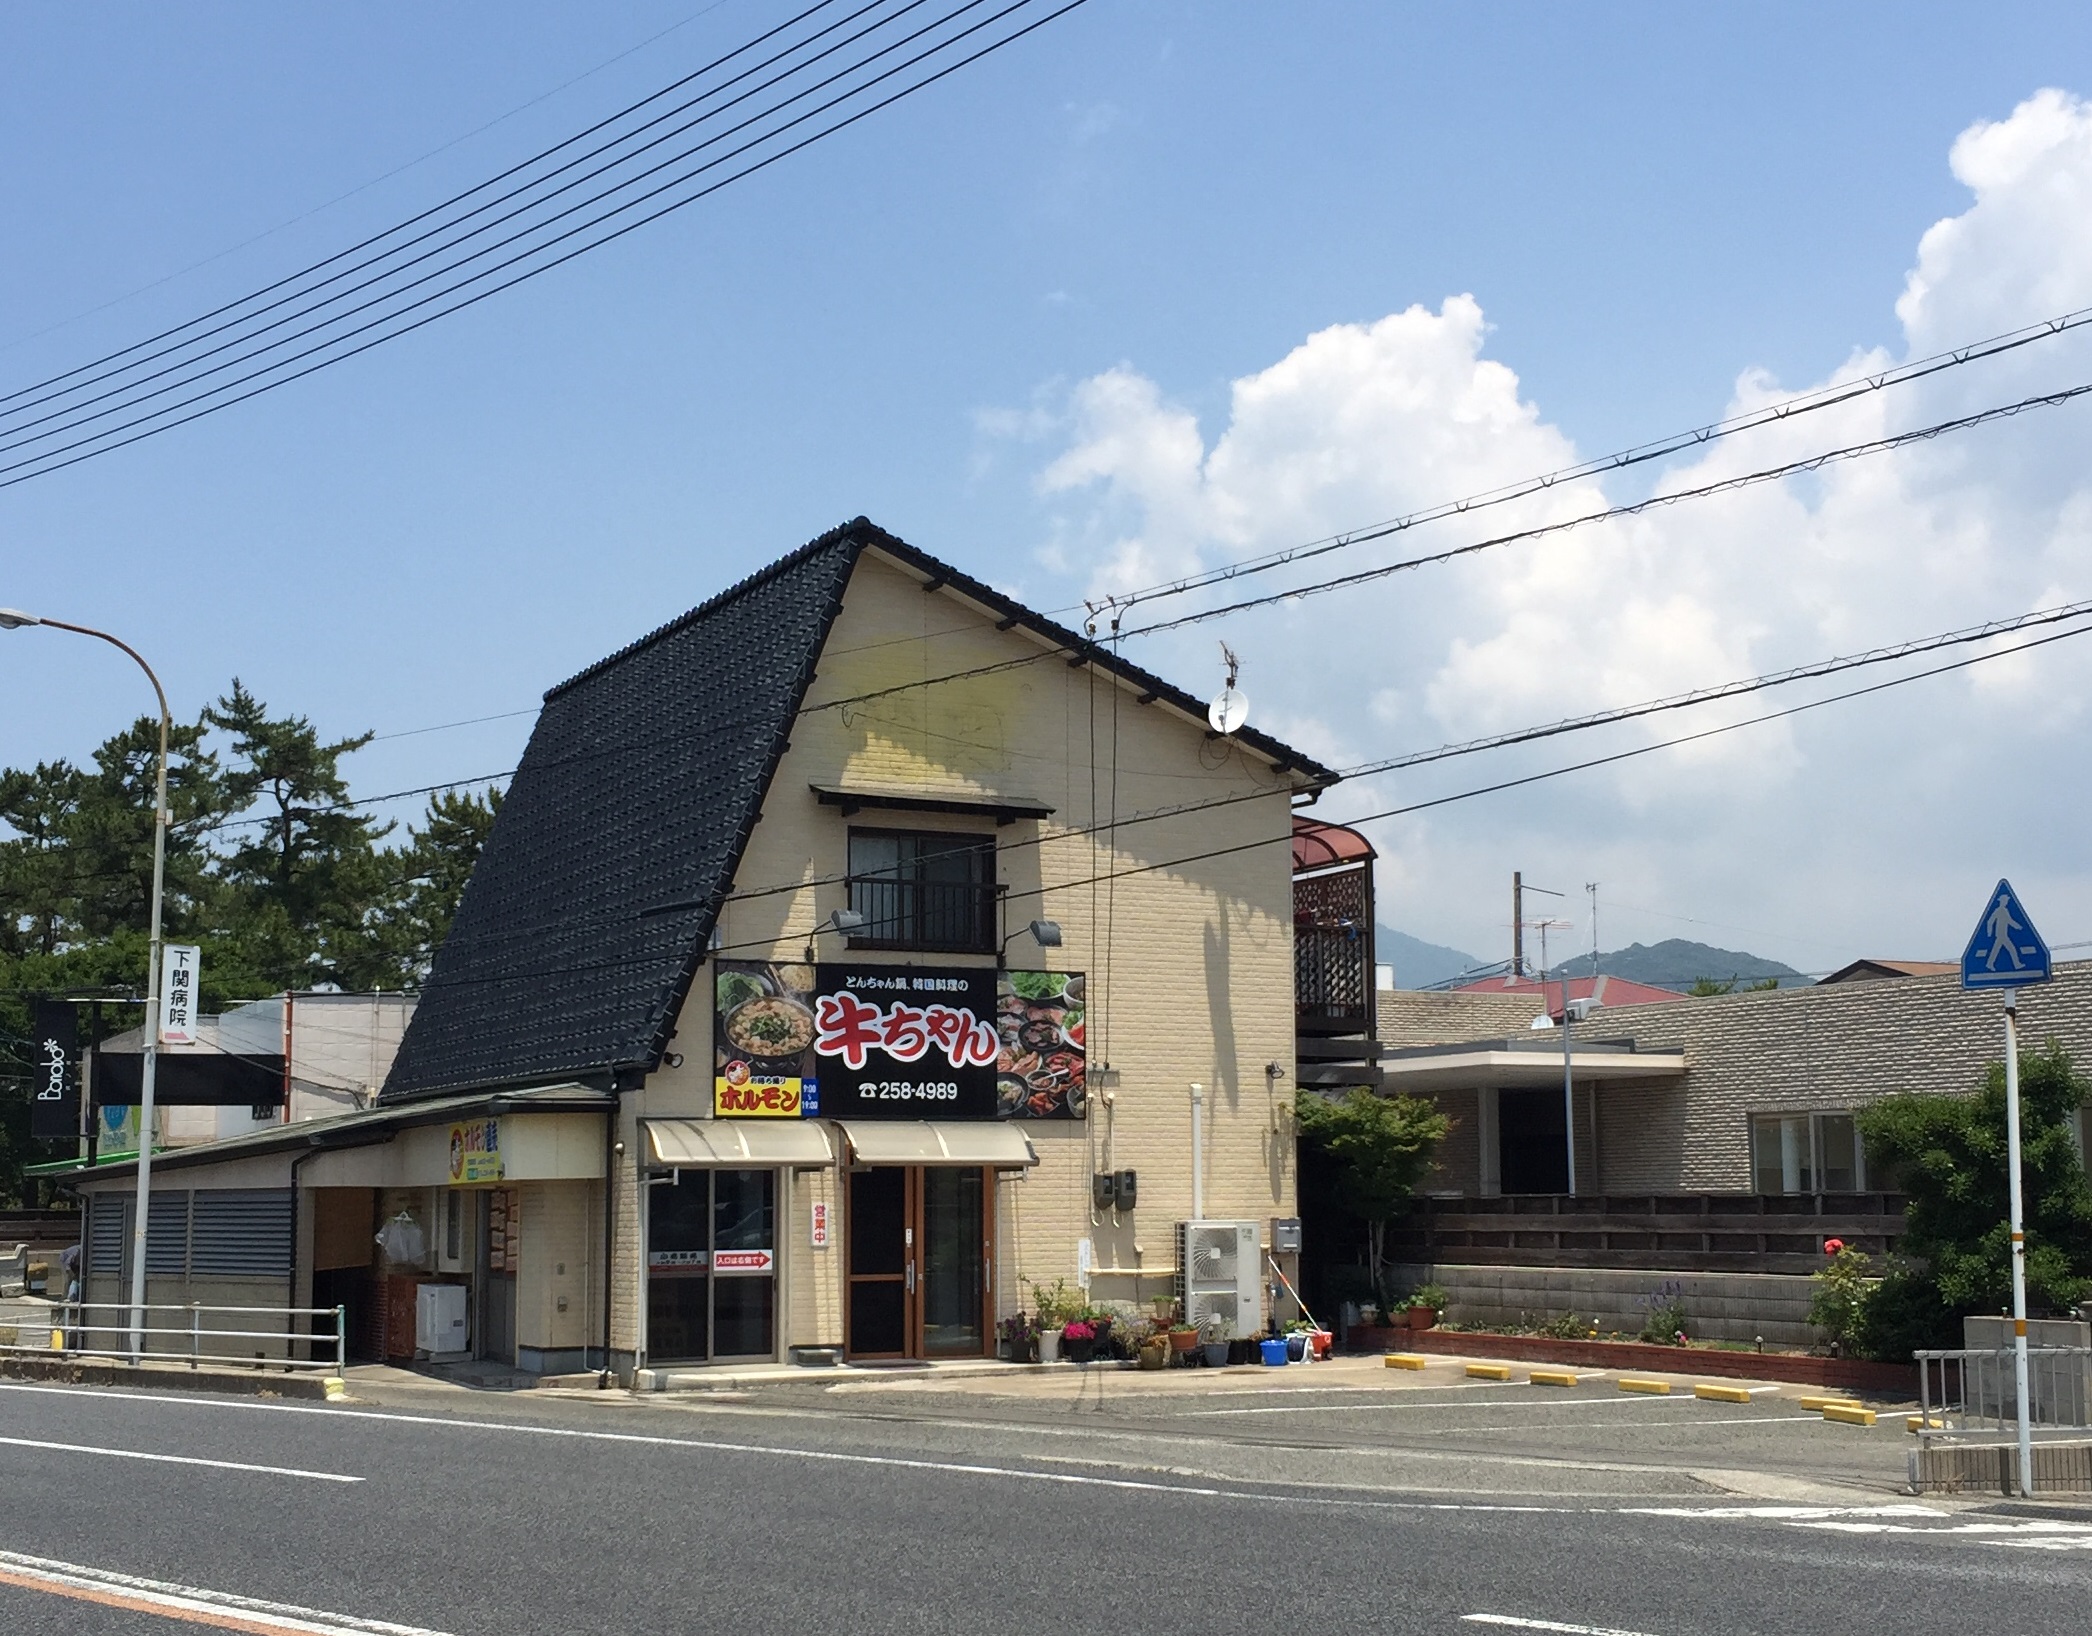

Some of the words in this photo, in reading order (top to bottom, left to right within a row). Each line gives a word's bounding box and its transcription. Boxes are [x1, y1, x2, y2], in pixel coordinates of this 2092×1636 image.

[169, 950, 191, 1026] 下関病院
[815, 992, 999, 1069] 牛ちゃん
[37, 1046, 65, 1100] Bonobo
[720, 1085, 800, 1112] ホルモン
[803, 1084, 817, 1093] 9:00
[879, 1082, 958, 1100] 258-4989
[801, 1101, 819, 1110] 19:00
